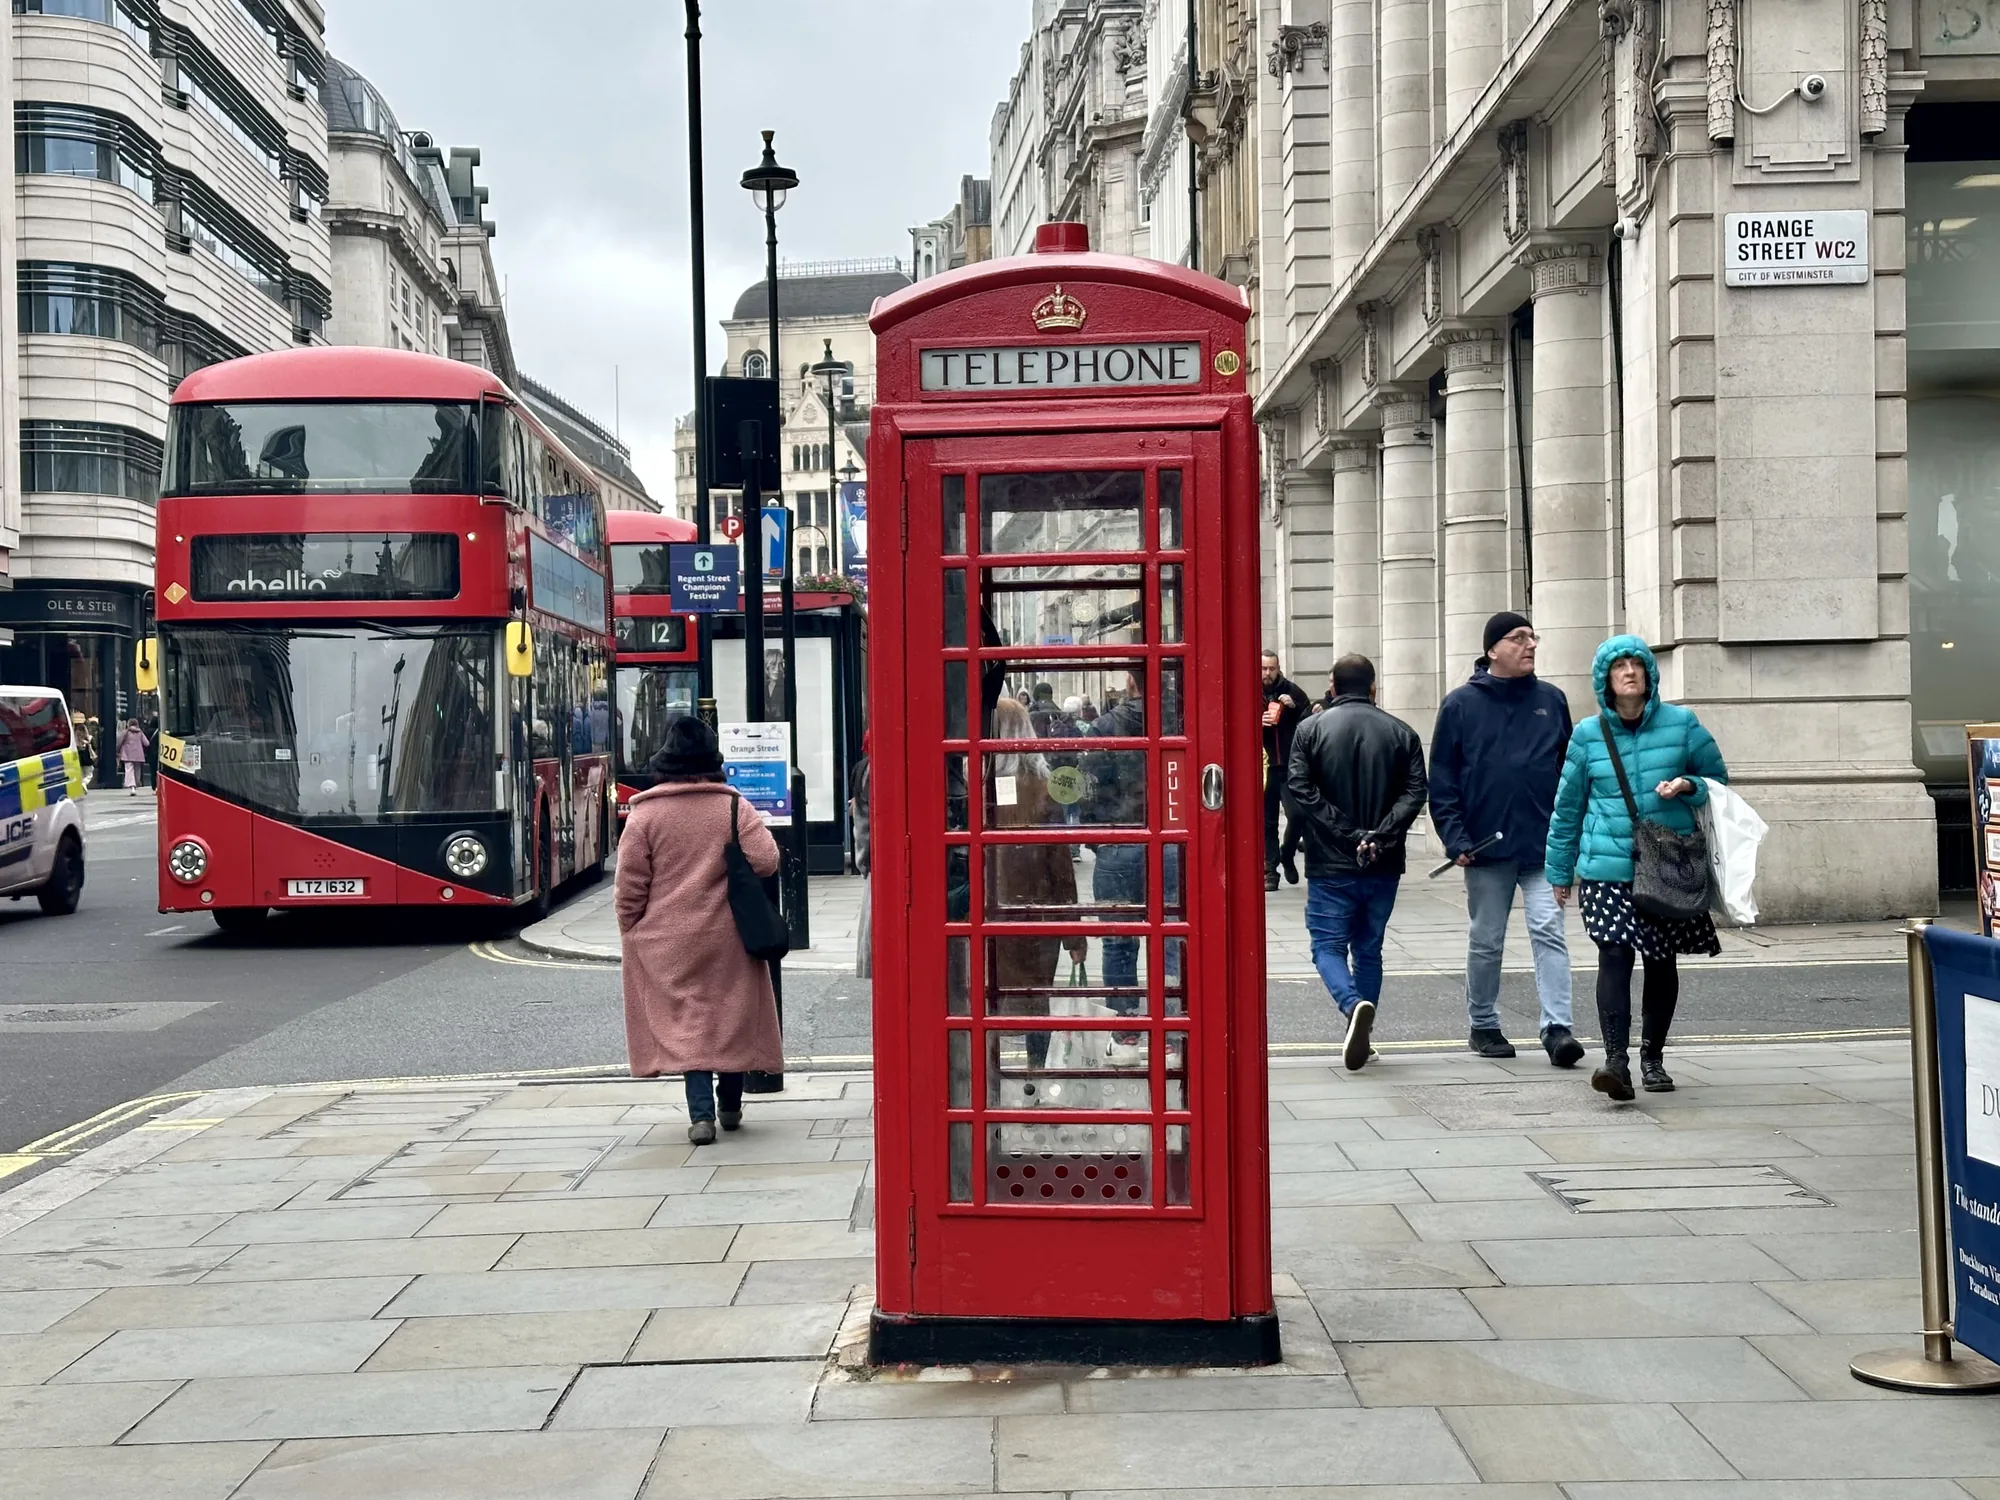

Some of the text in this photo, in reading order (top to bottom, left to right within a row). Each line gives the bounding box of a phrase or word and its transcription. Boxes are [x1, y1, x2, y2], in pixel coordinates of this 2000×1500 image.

[1737, 219, 1814, 239] ORANGE
[1738, 240, 1856, 261] STREET WC2
[1738, 270, 1834, 281] CITY OF WESTMINSTER
[931, 346, 1189, 386] TELEPHONE
[727, 519, 740, 536] P
[227, 569, 327, 591] abellio
[677, 574, 731, 584] Regent Street
[682, 583, 726, 592] Champions
[689, 592, 719, 600] Festival
[47, 600, 117, 612] OLE & STEEN
[651, 622, 670, 643] 12
[730, 744, 780, 753] Orange Street
[1167, 761, 1179, 821] PULL
[296, 880, 355, 894] LTZ 1632
